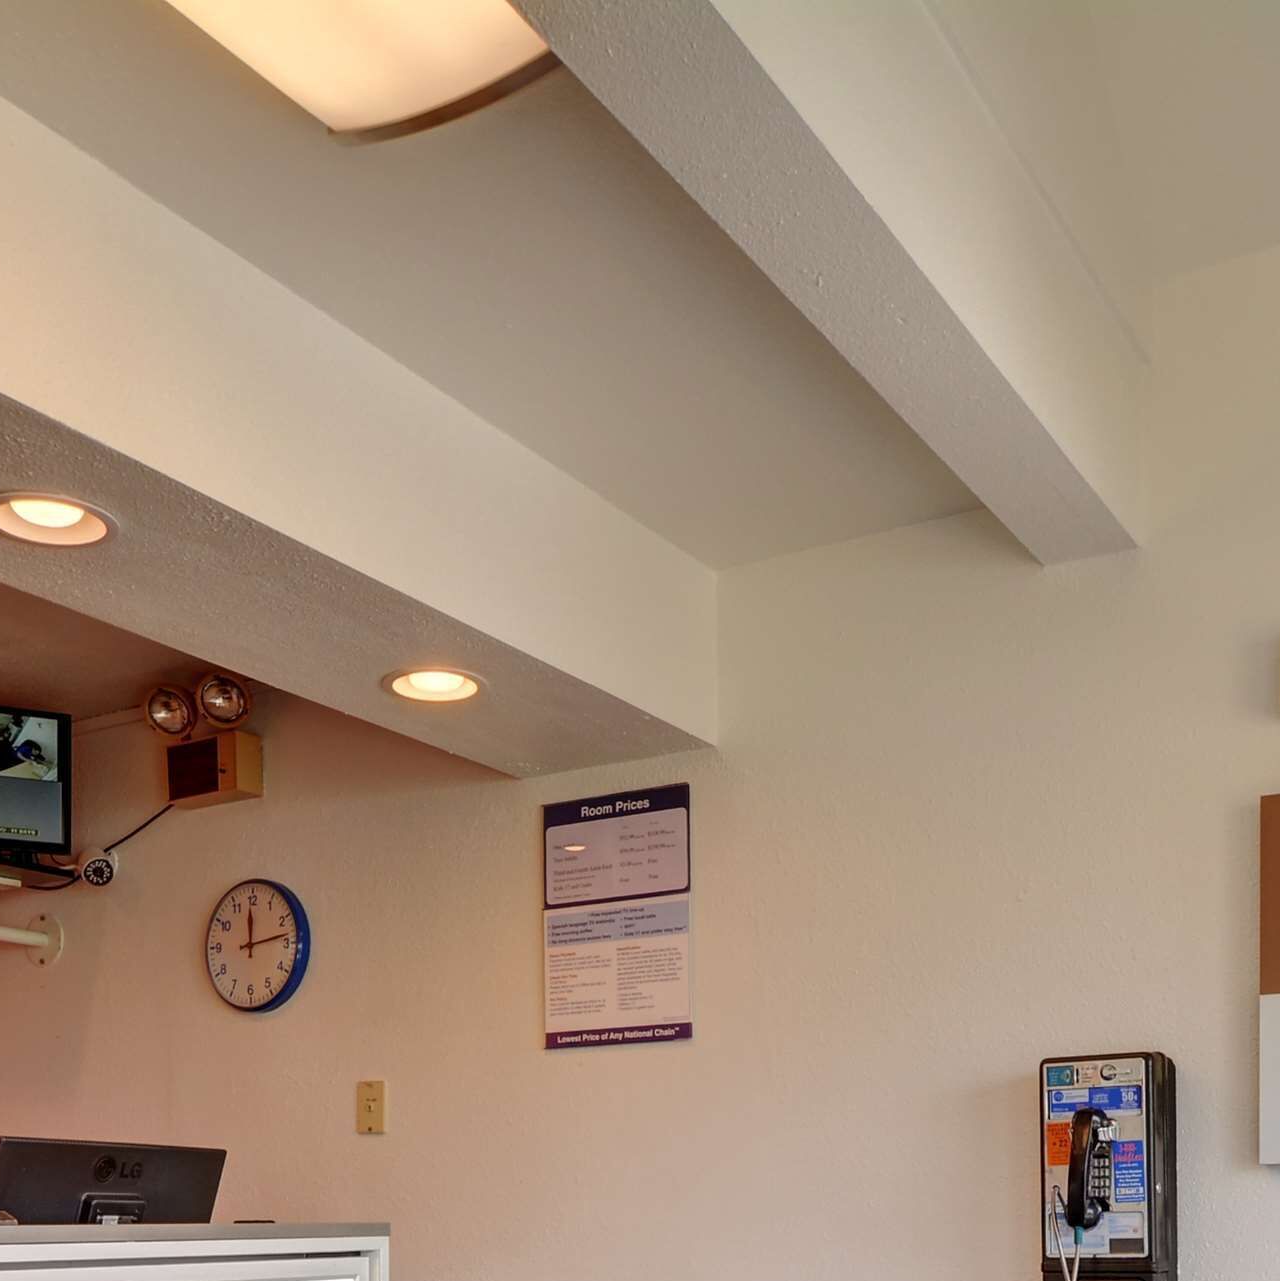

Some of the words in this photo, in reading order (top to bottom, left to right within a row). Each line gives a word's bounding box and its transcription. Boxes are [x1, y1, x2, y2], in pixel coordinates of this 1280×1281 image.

[581, 804, 613, 818] Room
[615, 798, 650, 812] Prices
[248, 895, 258, 906] 12
[232, 903, 241, 914] 11
[221, 921, 231, 932] 10
[279, 915, 285, 927] 2
[215, 942, 222, 953] 9
[283, 938, 290, 949] 3
[220, 964, 227, 975] 8
[277, 961, 284, 971] 4
[264, 977, 271, 989] 5
[247, 984, 254, 995] 6
[557, 1034, 581, 1044] Lowest
[582, 1032, 600, 1041] Price
[601, 1032, 609, 1040] of
[609, 1031, 623, 1041] Any
[624, 1029, 653, 1039] National
[119, 1162, 144, 1179] LG
